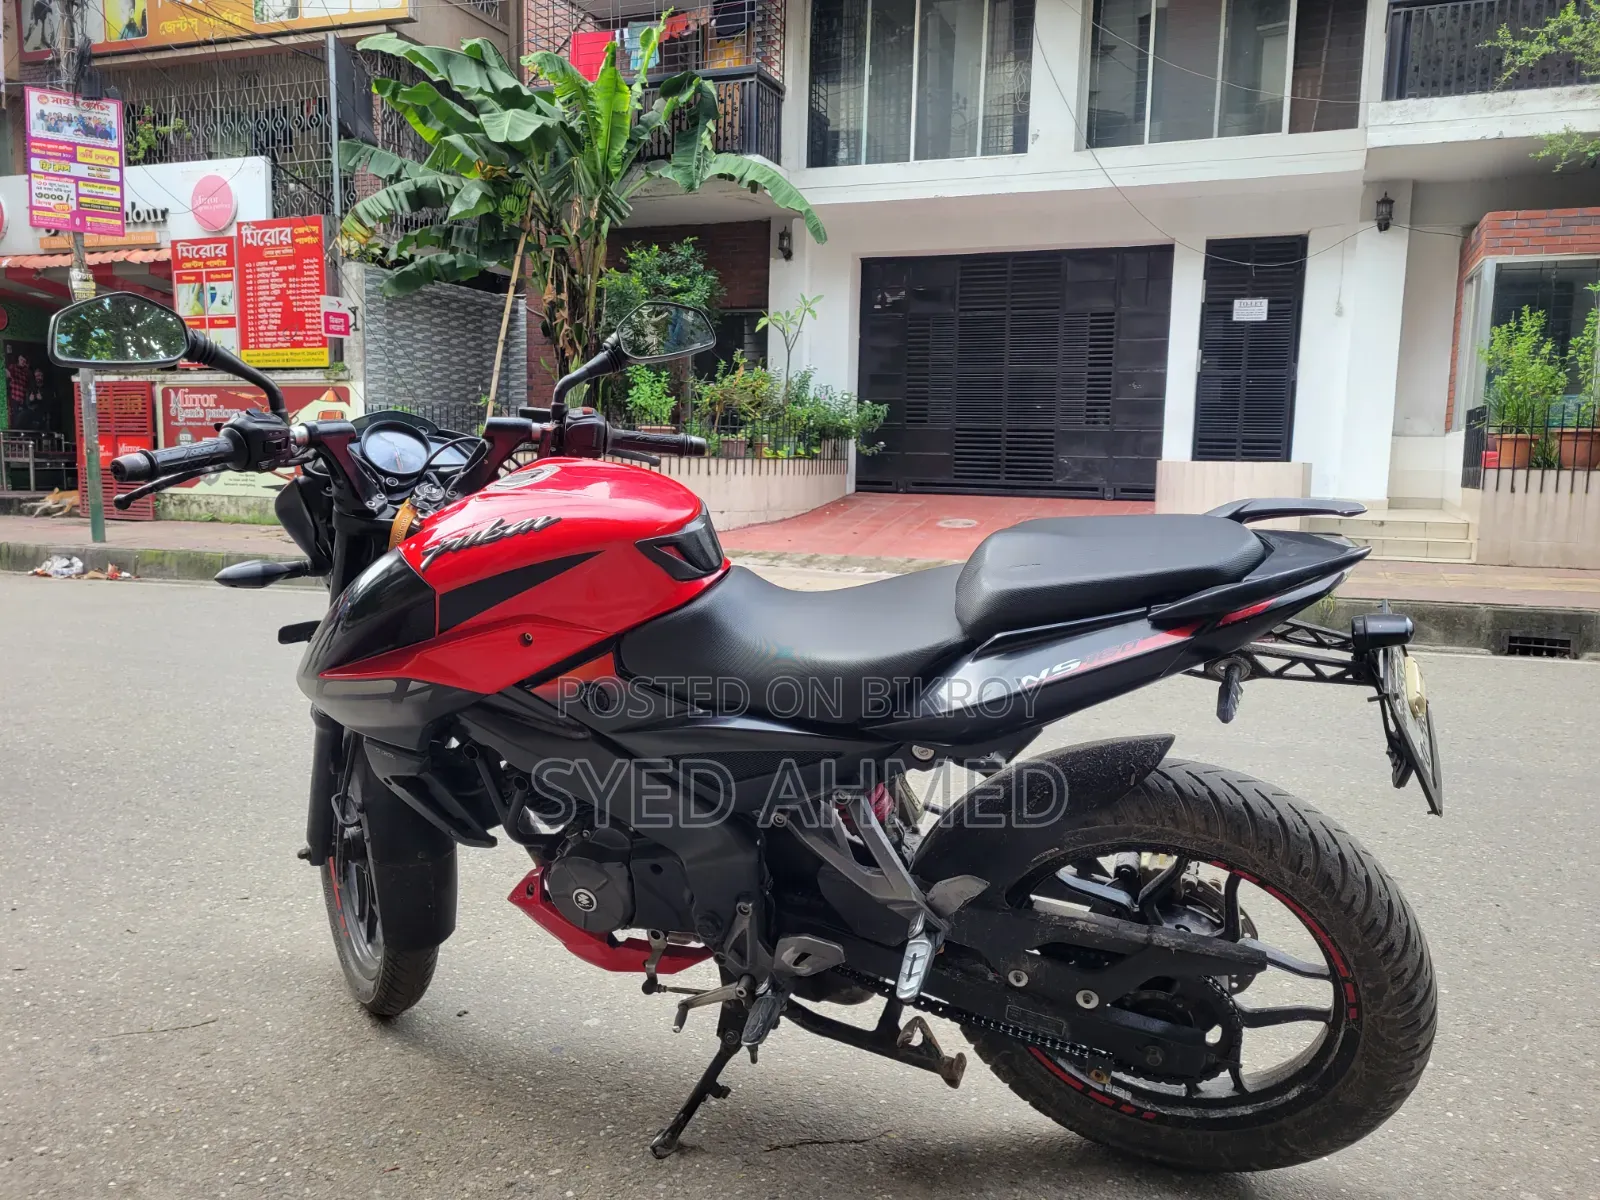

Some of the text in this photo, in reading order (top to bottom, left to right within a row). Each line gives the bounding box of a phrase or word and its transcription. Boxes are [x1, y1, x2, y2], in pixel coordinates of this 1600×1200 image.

[240, 224, 293, 248] মিরোর
[176, 242, 228, 260] মিরোর
[168, 388, 217, 408] Mirror
[420, 516, 562, 572] Pulsar
